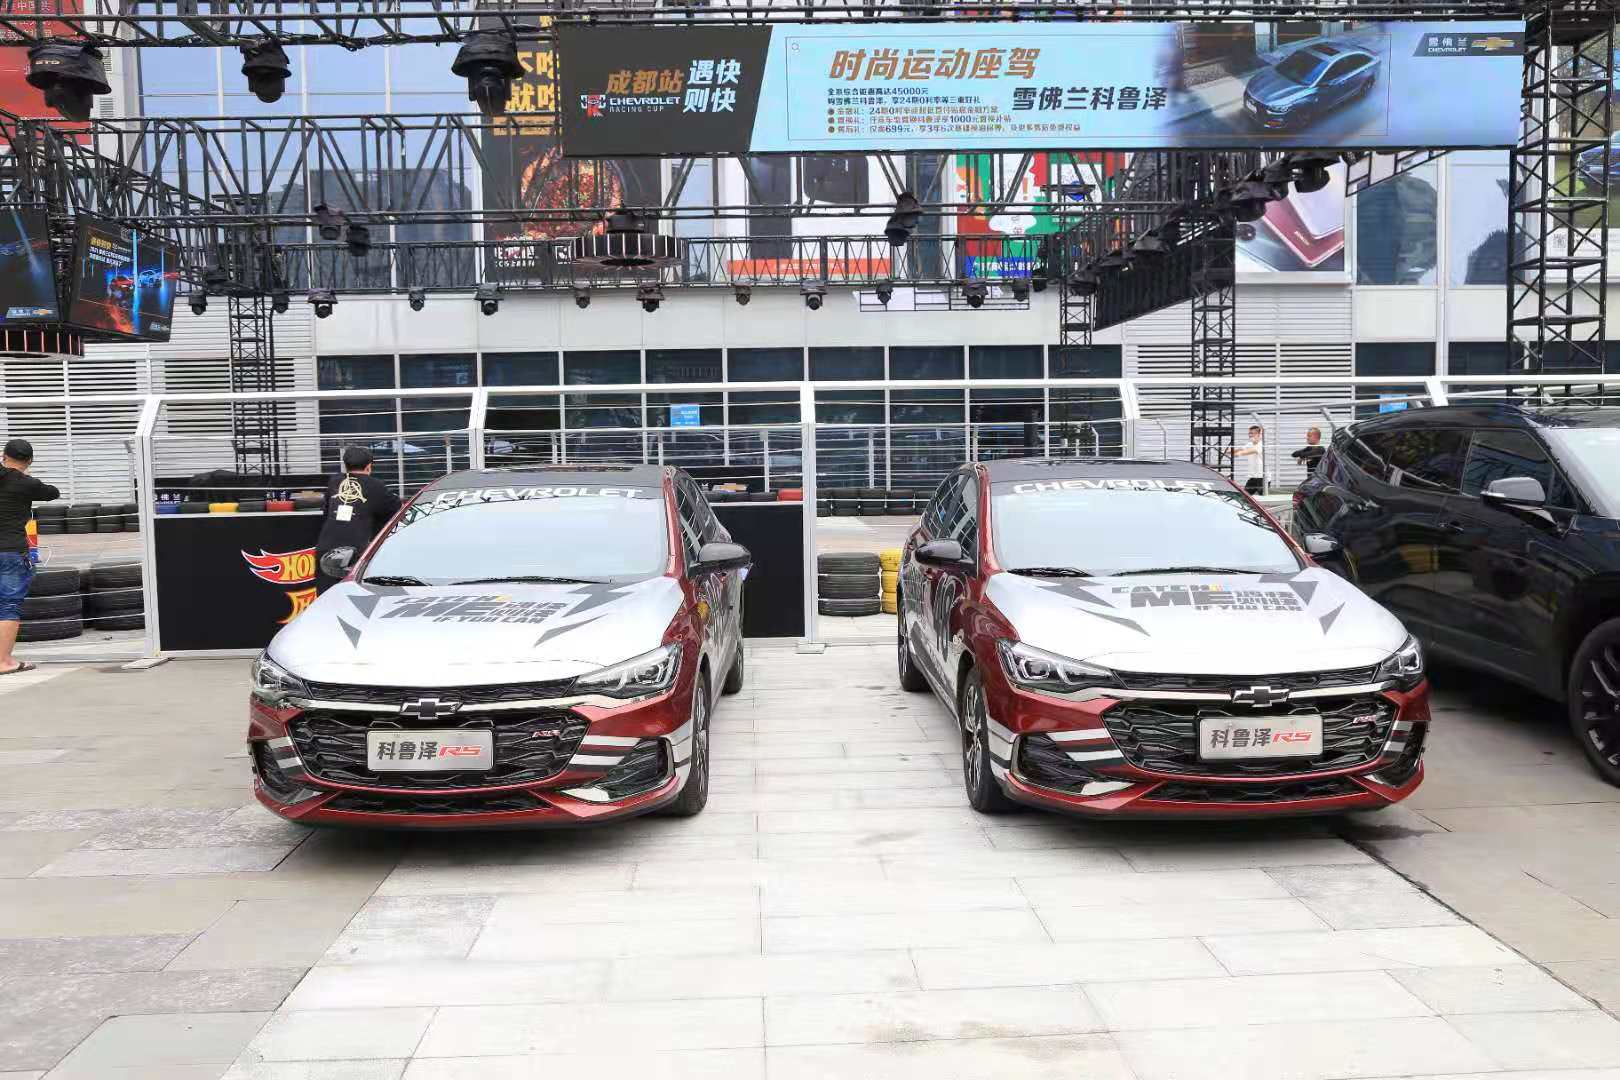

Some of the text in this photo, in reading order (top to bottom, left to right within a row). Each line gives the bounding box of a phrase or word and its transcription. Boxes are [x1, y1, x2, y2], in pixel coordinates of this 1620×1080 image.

[687, 59, 741, 85] 遇快
[829, 48, 1041, 81] 时尚运动座驾
[605, 69, 685, 95] 成都站
[609, 96, 681, 105] CHEVROLET
[682, 87, 737, 114] 则快
[1012, 86, 1168, 111] 雪佛兰科鲁泽
[434, 487, 642, 502] CHEVROLET
[1013, 480, 1215, 494] CHEVROLET
[1131, 590, 1237, 608] ME
[500, 616, 546, 624] CAN
[1210, 728, 1313, 748] 科鲁泽 RS
[377, 740, 482, 760] 科鲁泽 RS
